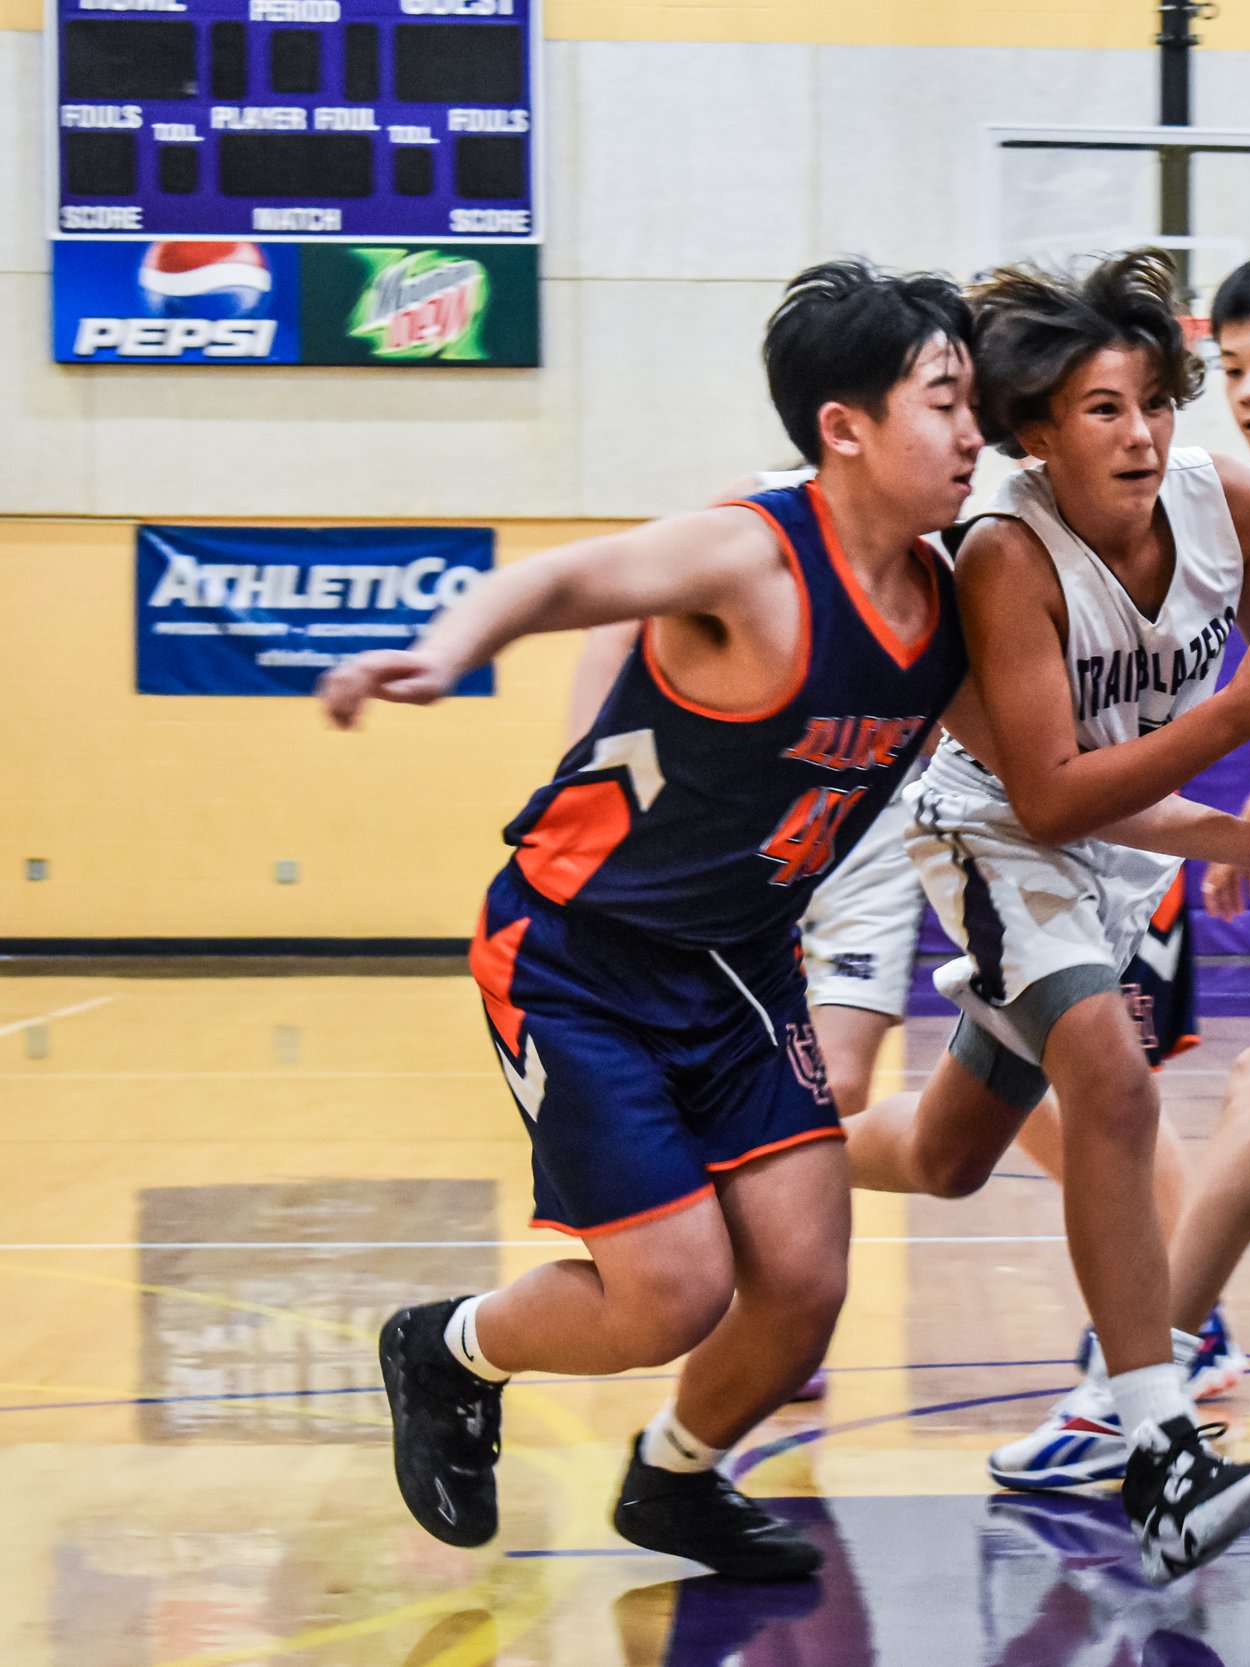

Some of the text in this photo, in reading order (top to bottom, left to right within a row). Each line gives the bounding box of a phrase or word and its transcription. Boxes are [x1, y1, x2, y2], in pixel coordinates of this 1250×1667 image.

[250, 0, 340, 22] PERIOD
[61, 105, 142, 129] FOULS
[211, 107, 380, 131] PLAYER FOUL
[448, 108, 529, 132] FOULS
[61, 206, 143, 230] SCORE
[253, 208, 342, 231] MATCH
[450, 209, 531, 233] SCORE
[73, 318, 278, 356] PEPSI
